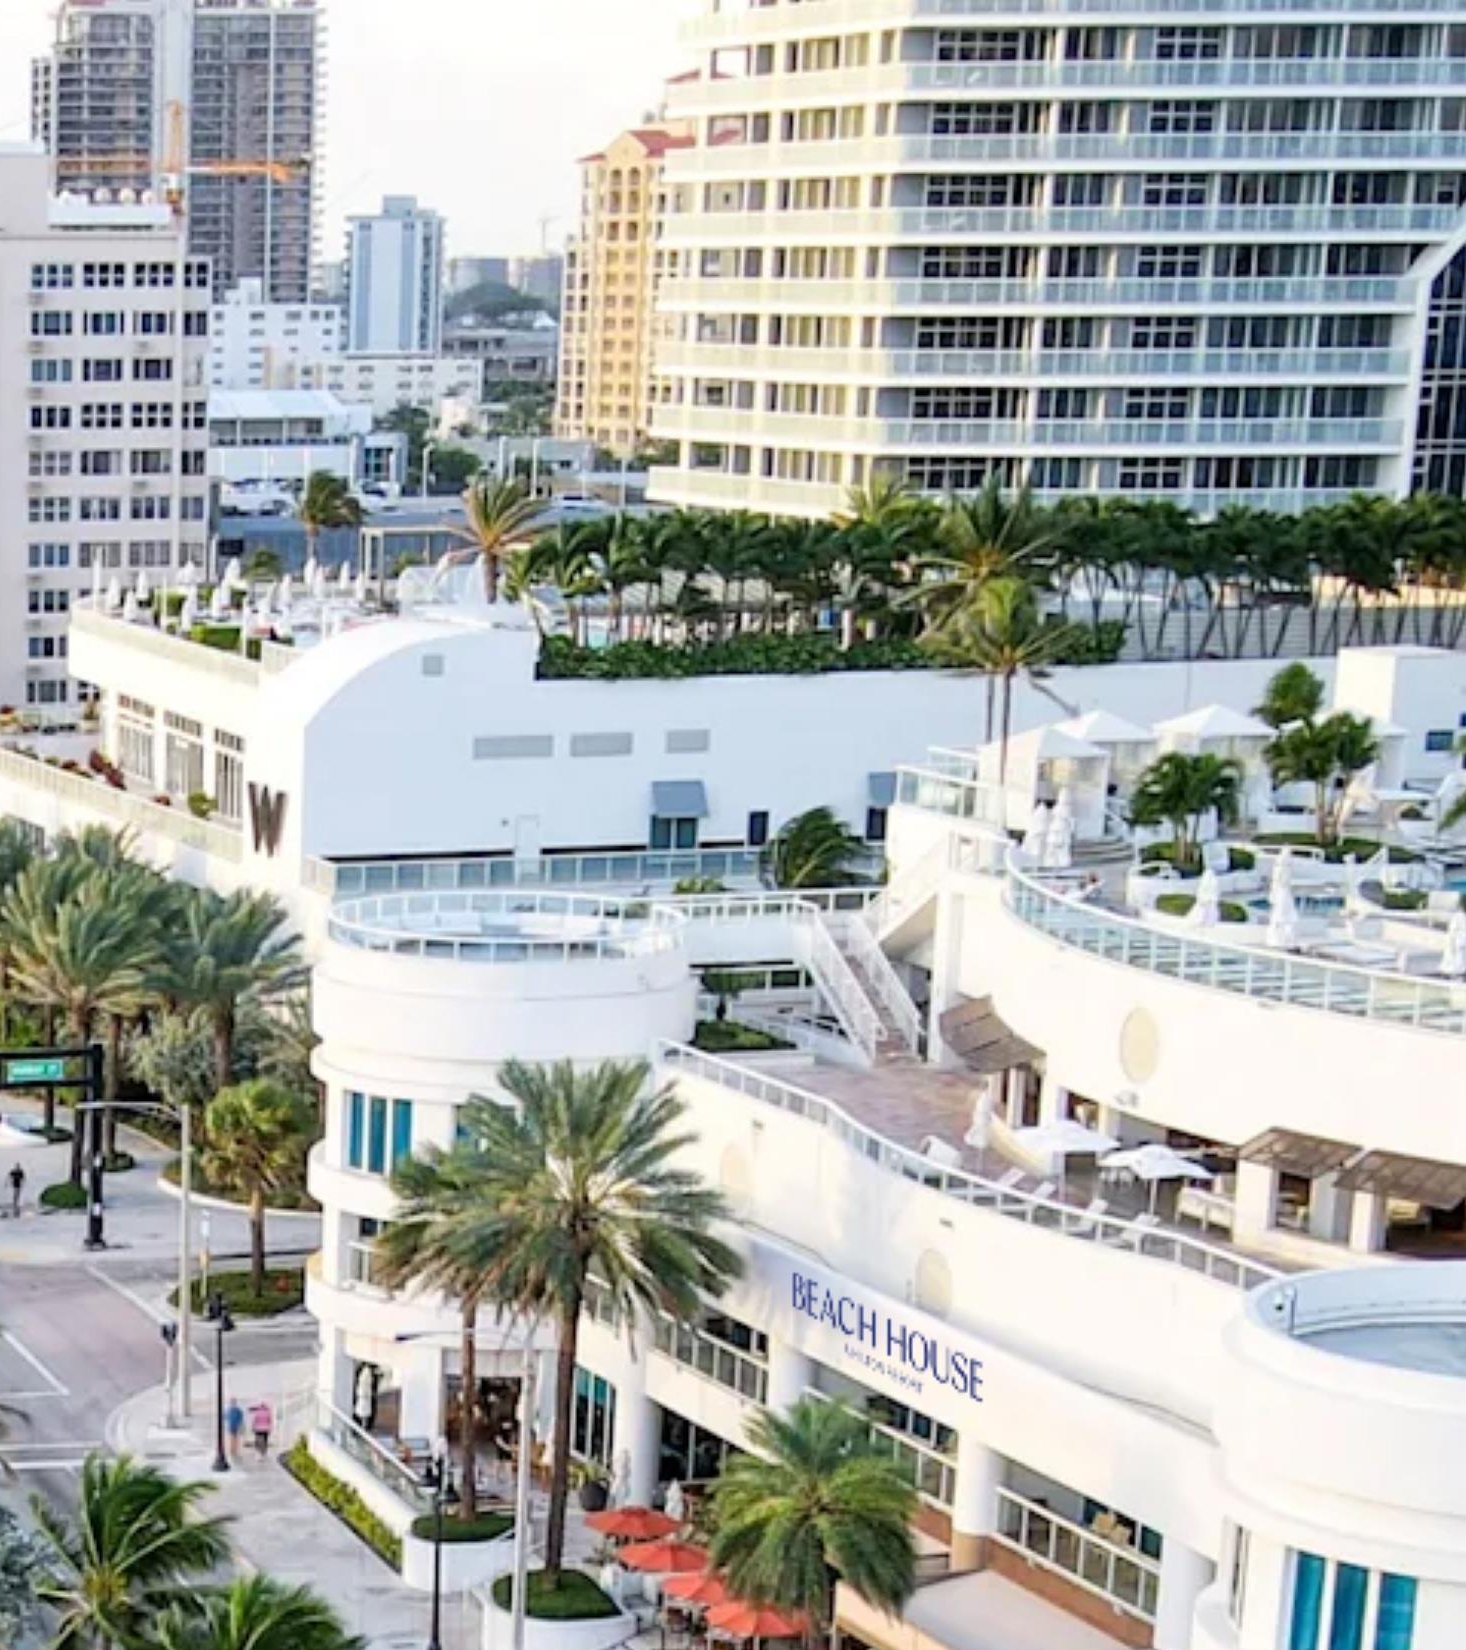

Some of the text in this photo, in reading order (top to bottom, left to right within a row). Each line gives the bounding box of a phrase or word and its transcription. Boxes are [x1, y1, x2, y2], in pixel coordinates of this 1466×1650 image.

[247, 781, 287, 858] W
[791, 1271, 877, 1348] BEACH
[886, 1317, 984, 1403] HOUSE
